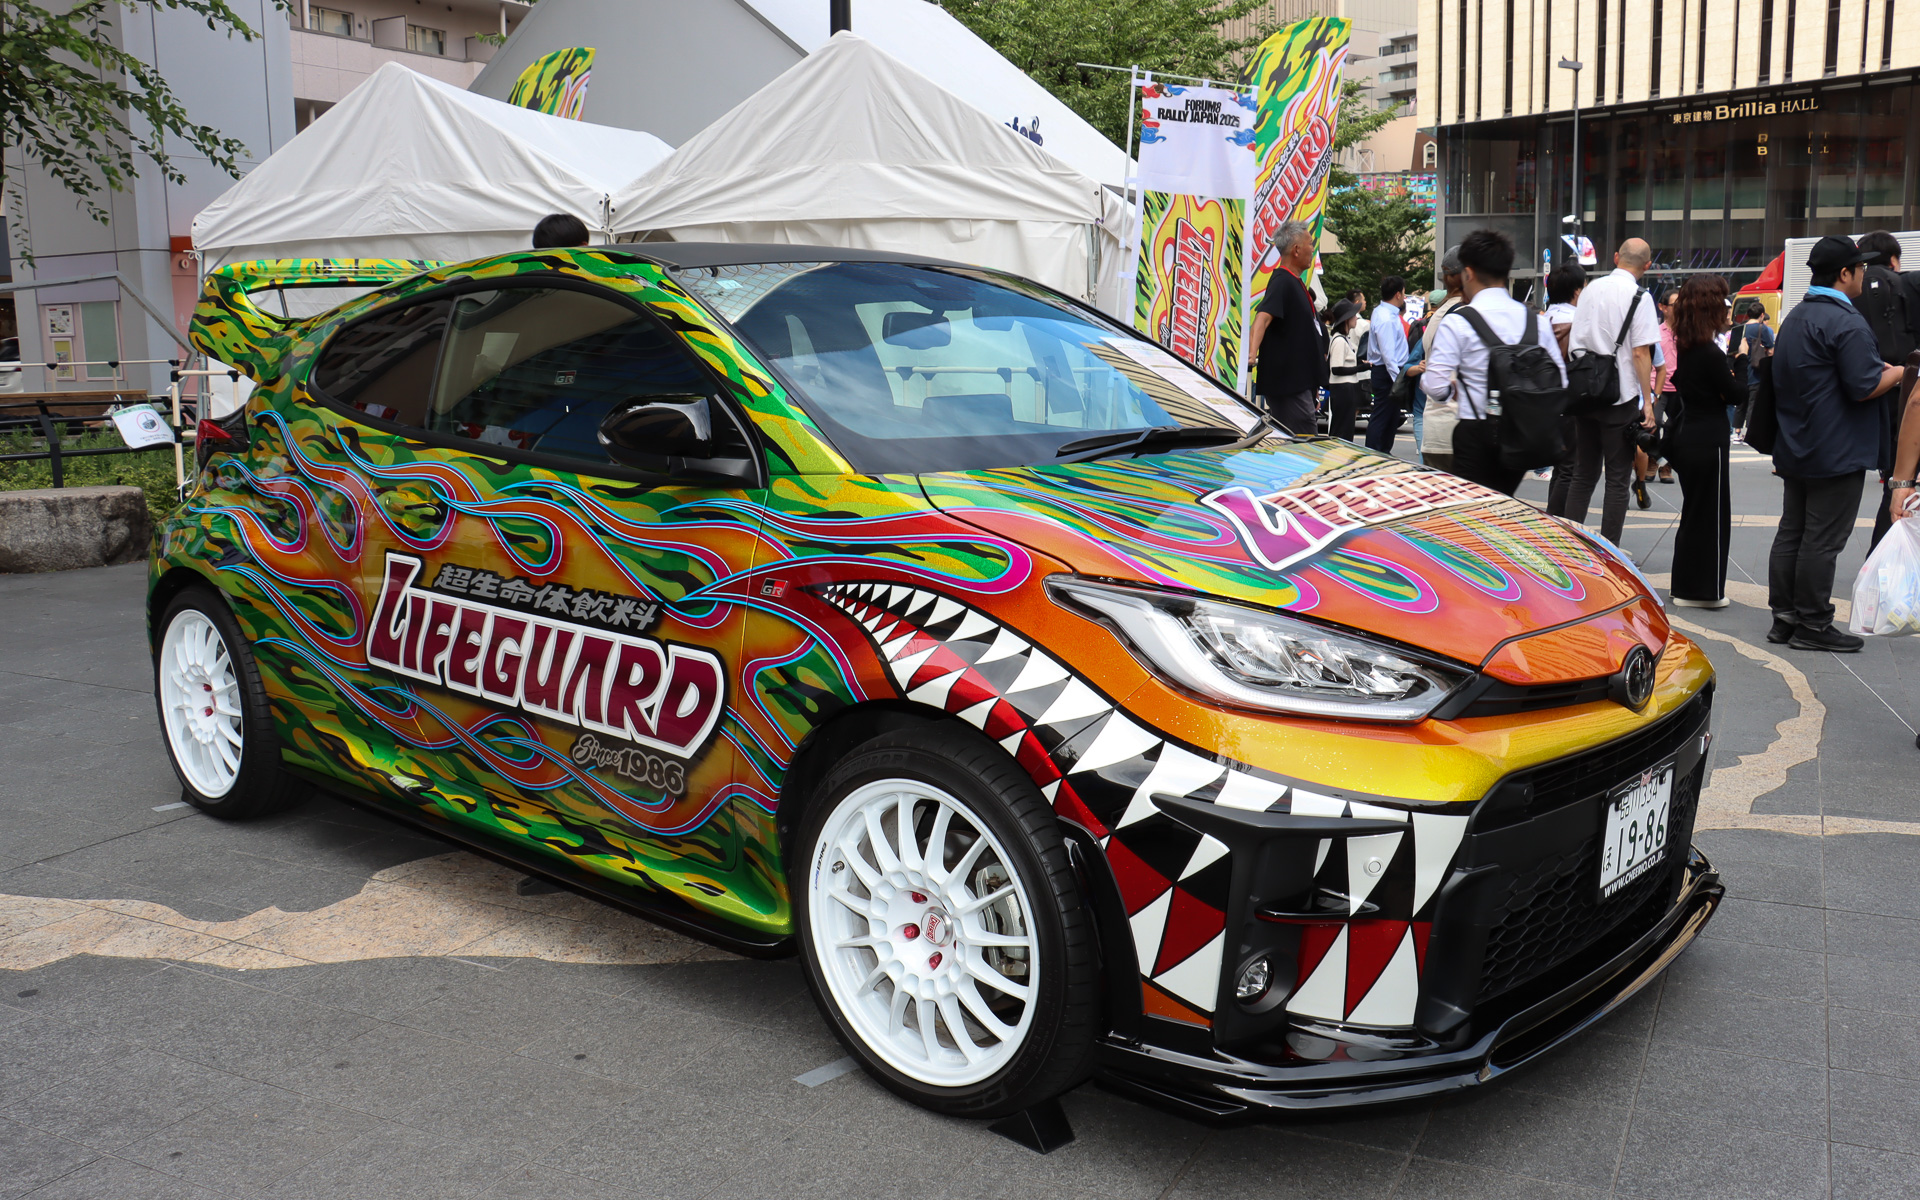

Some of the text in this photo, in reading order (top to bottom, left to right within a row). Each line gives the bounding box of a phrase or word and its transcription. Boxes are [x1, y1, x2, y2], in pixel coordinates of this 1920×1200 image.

[1157, 107, 1240, 127] RALLY JAPAN 2025
[1185, 99, 1222, 113] FORUM8
[1672, 98, 1819, 124] 東京建物 Brillia HALL
[1319, 145, 1333, 177] 1986
[433, 564, 658, 631] 超生命体飲料
[367, 552, 725, 759] LIFEGUARD
[572, 734, 685, 795] Since 1986
[1616, 801, 1667, 875] 19-86
